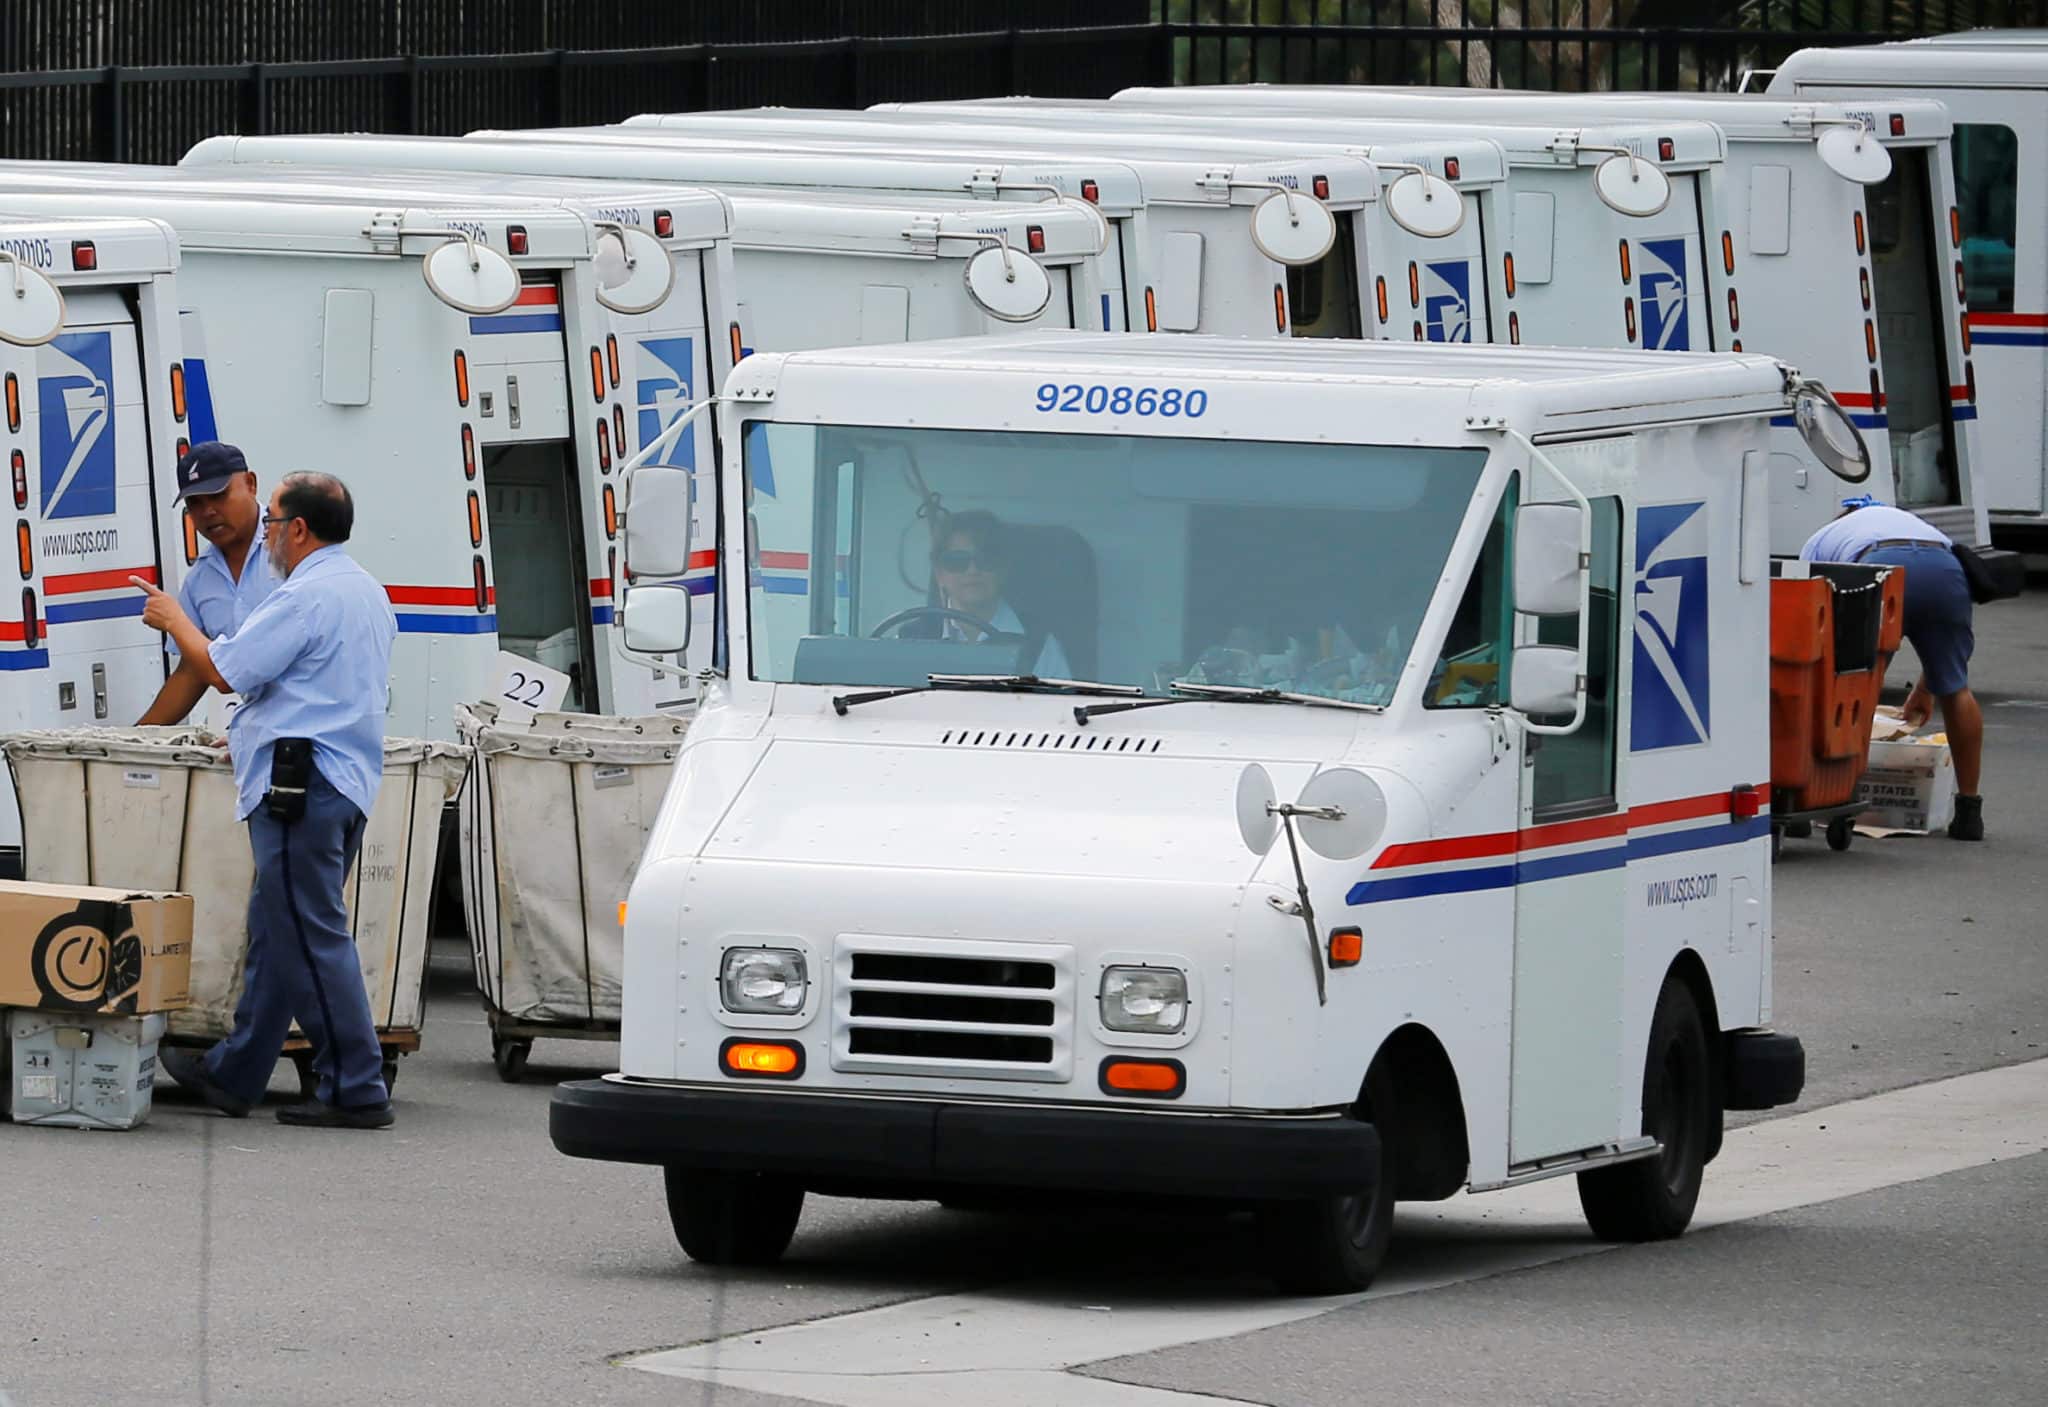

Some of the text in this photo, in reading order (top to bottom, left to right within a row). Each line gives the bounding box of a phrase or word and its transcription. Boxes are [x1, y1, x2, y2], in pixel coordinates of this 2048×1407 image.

[1036, 383, 1208, 418] 9208680
[42, 529, 118, 561] www.usps.com
[504, 671, 545, 709] 22
[1872, 784, 1916, 797] STATES
[1647, 873, 1718, 911] www.usps.com
